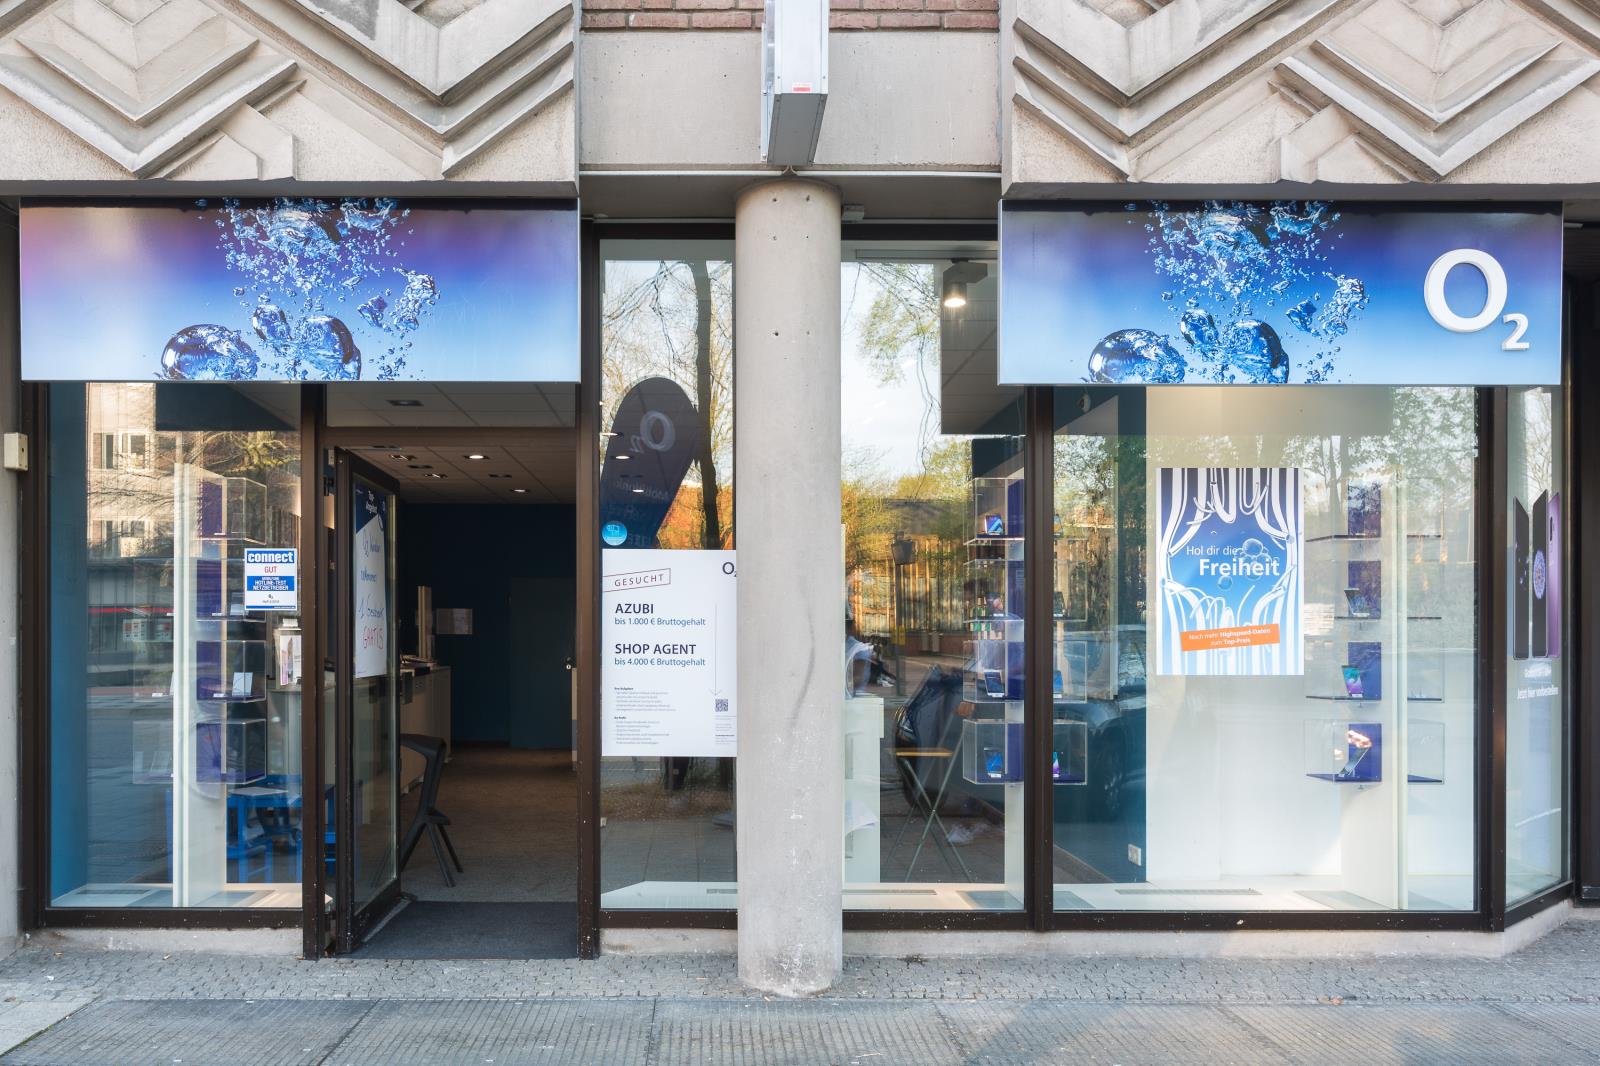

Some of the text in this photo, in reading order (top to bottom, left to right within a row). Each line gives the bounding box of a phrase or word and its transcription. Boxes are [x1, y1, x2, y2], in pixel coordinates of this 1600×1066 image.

[1423, 248, 1530, 351] O2
[1186, 545, 1238, 556] Hol dir die
[247, 551, 294, 563] connect
[264, 566, 277, 574] GUT
[1199, 558, 1280, 576] Freiheit
[614, 573, 664, 587] GESUCHT
[615, 603, 654, 614] AZUBI
[614, 617, 626, 625] bis
[628, 617, 649, 625] 1.000
[656, 617, 706, 628] Bruttogehalt
[615, 643, 697, 655] SHOP AGENT
[614, 657, 706, 668] bis 4.000 € Bruttogehalt
